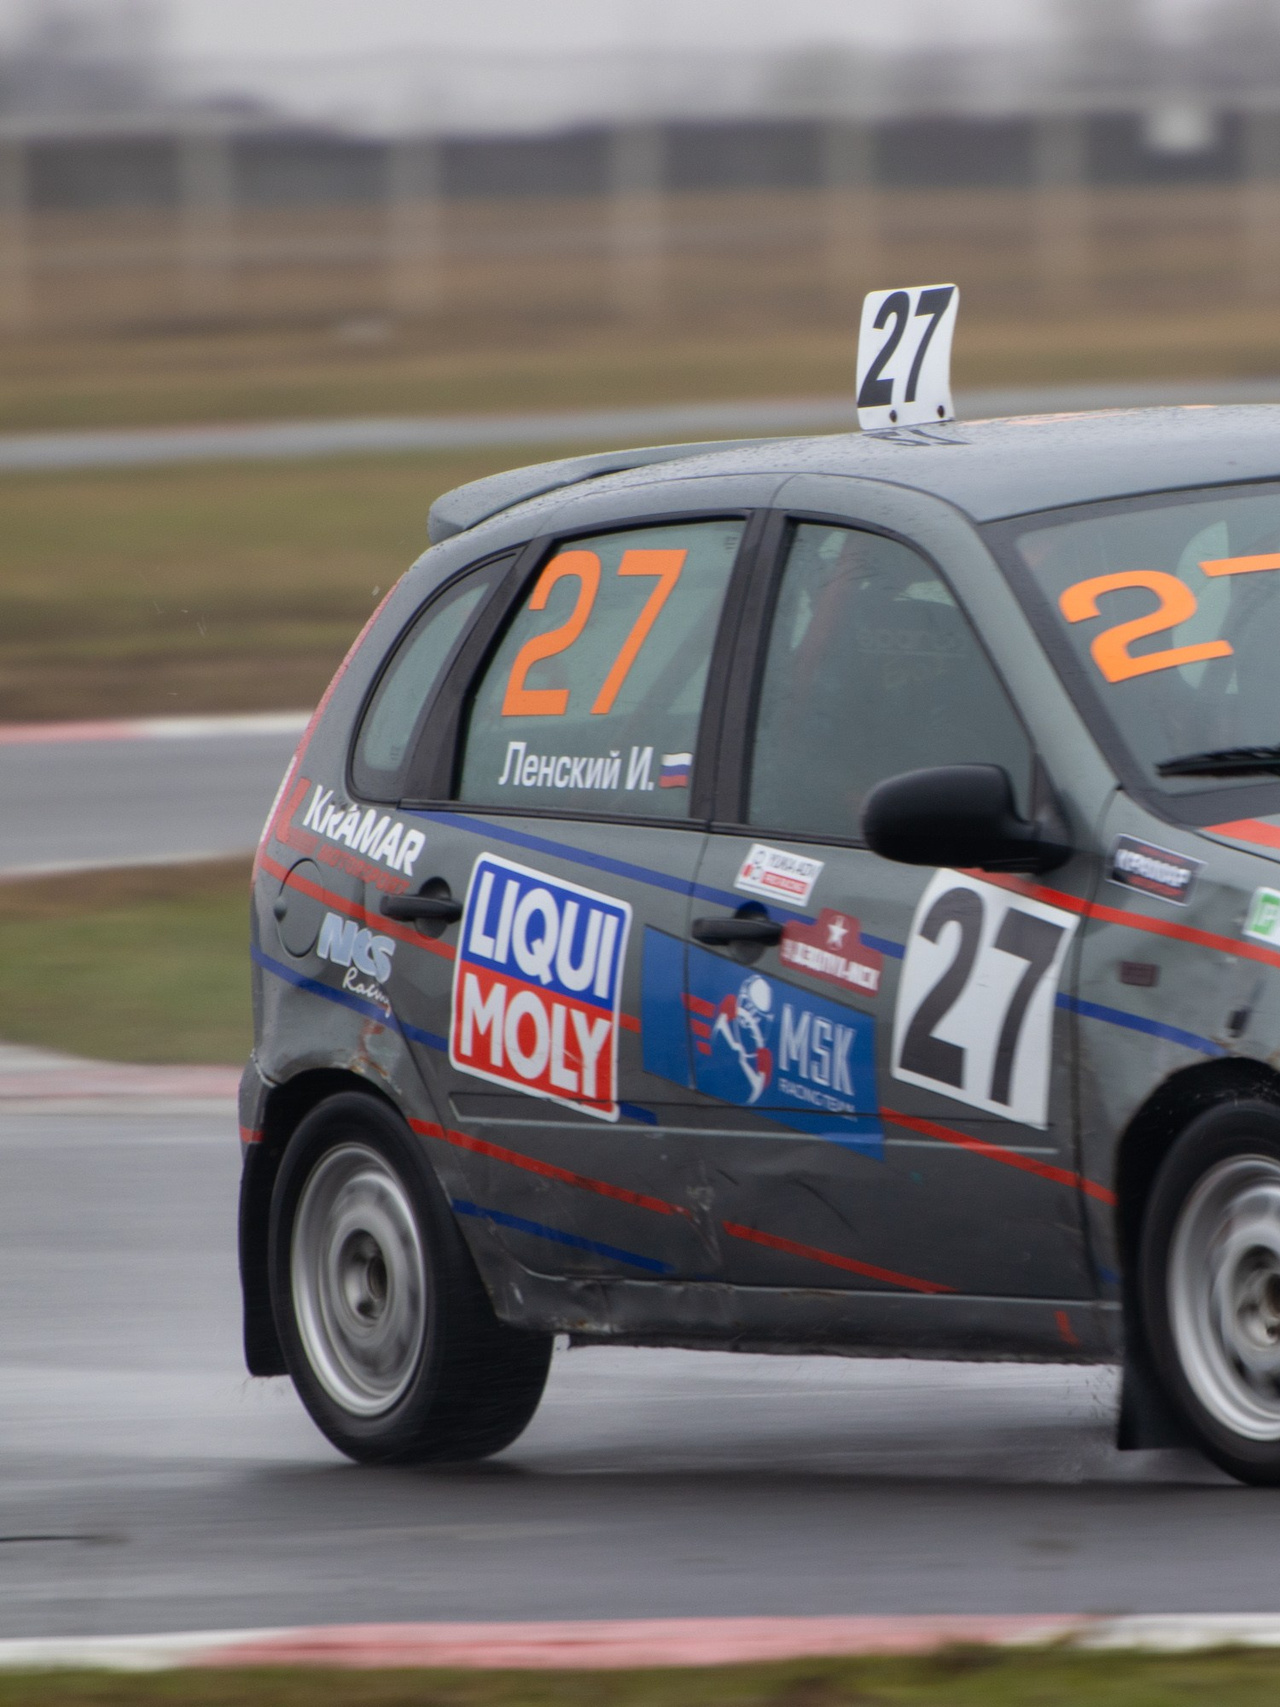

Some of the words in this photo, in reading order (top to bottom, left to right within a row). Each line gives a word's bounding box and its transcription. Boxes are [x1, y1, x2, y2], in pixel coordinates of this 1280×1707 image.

[857, 286, 956, 408] 27
[501, 549, 688, 716] 27
[498, 741, 621, 790] Ленский
[624, 746, 655, 791] И.
[468, 871, 619, 1000] LIQUI
[900, 887, 1066, 1108] 27
[460, 973, 612, 1099] MOLY
[779, 1003, 856, 1096] MSK
